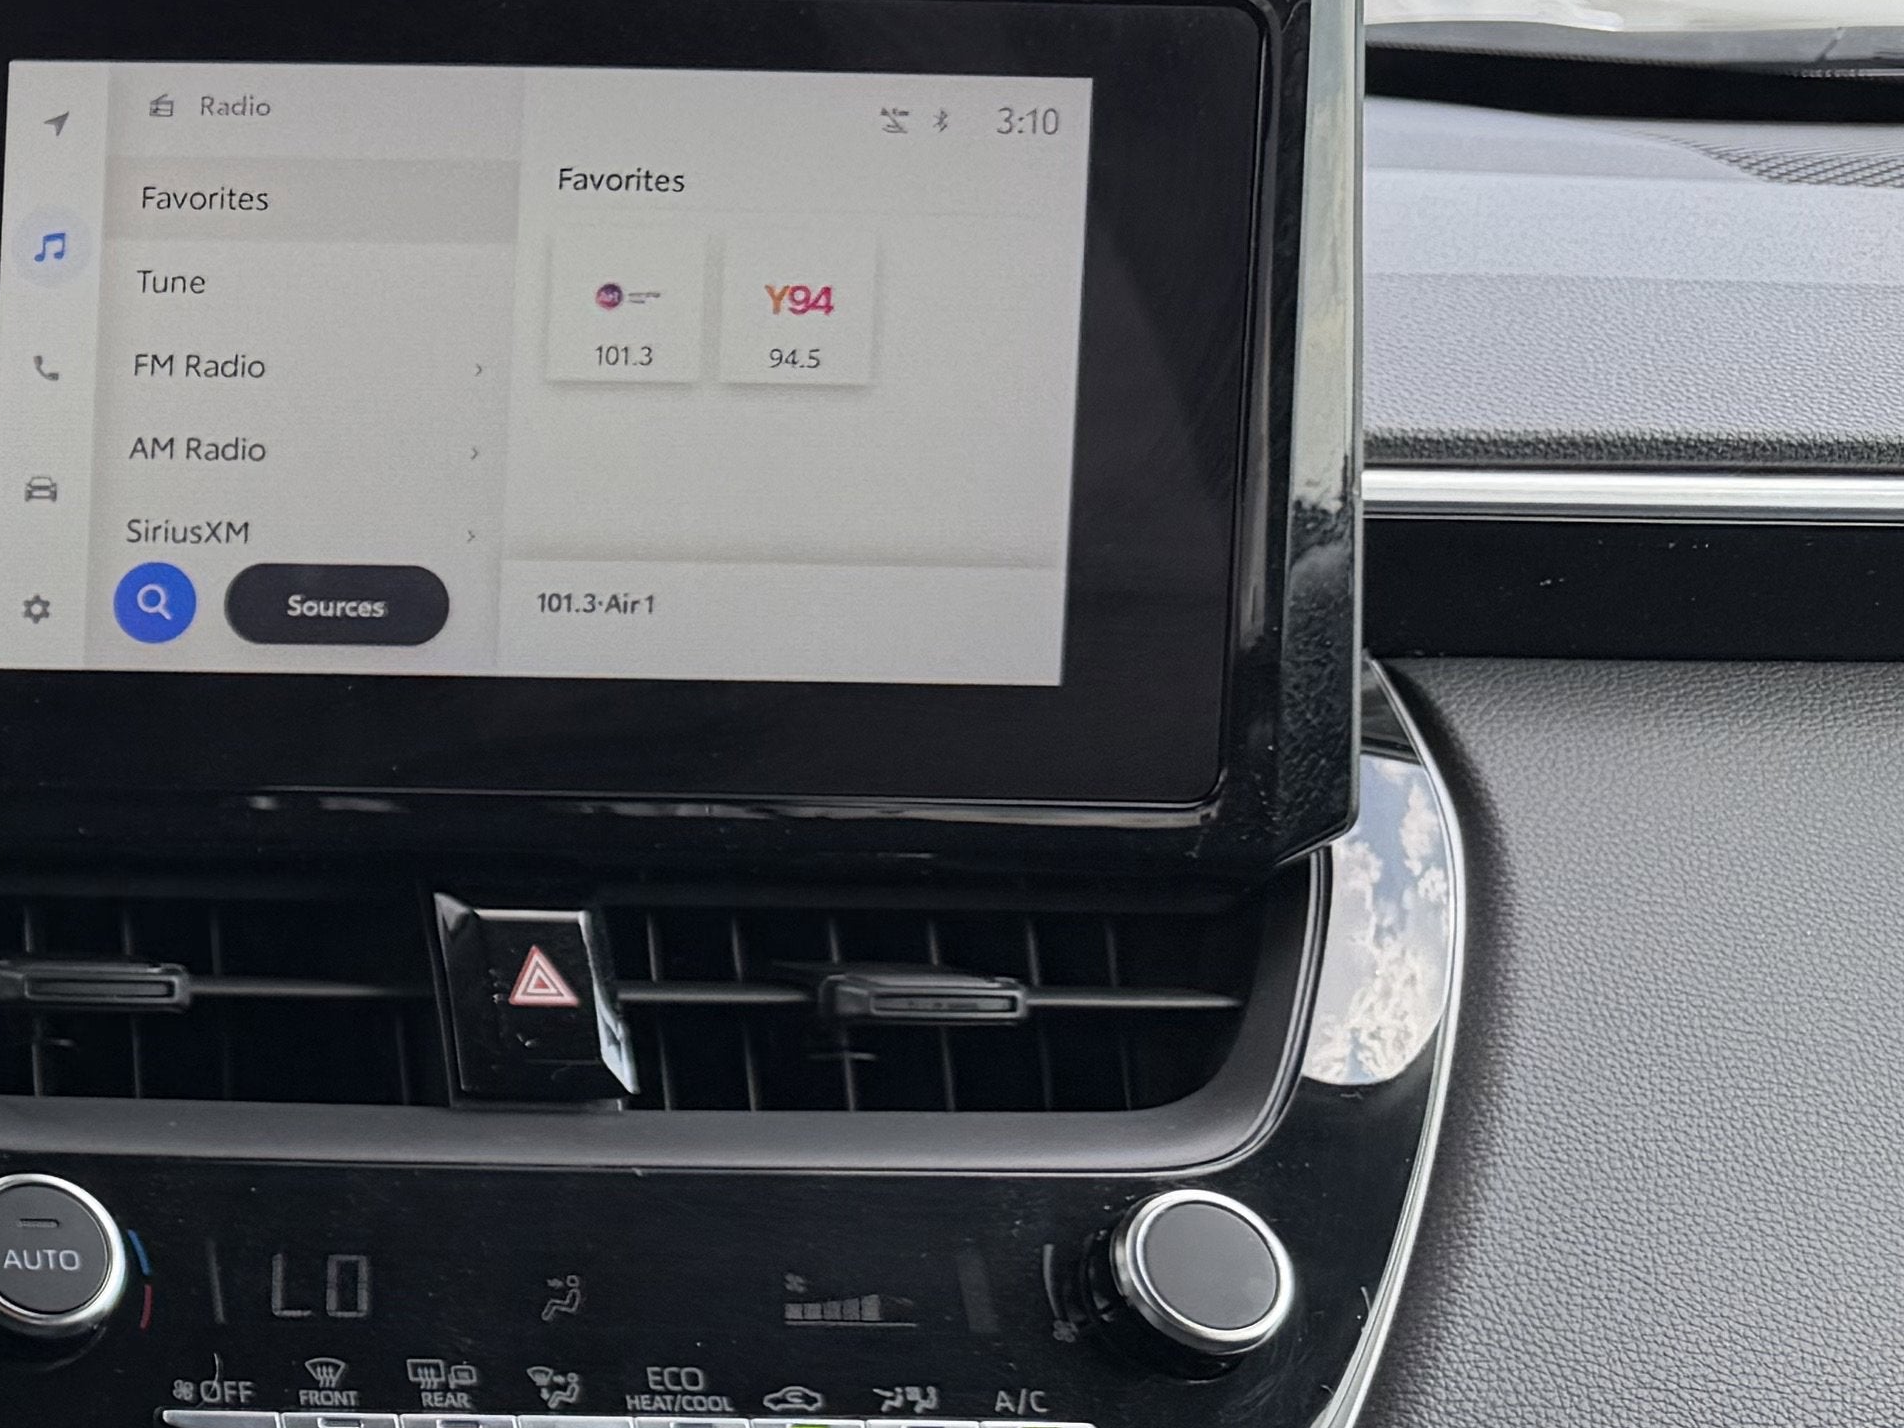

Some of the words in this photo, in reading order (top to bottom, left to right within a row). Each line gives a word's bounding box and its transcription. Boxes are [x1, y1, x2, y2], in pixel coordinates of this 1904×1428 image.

[200, 95, 272, 117] Radio
[997, 107, 1060, 135] 3:10
[558, 168, 685, 193] Favorites
[142, 186, 270, 211] Favorites
[137, 270, 206, 294] Tune
[764, 284, 835, 316] Y94
[134, 353, 175, 377] FM
[185, 353, 266, 378] Radio
[595, 345, 653, 366] 101.3
[769, 348, 821, 369] 94.5
[129, 437, 174, 460] AM
[186, 437, 267, 462] Radio
[126, 518, 249, 544] SiriusXM
[286, 594, 387, 618] Sources
[3, 1248, 80, 1271] AUTO
[646, 1367, 706, 1391] ECO
[200, 1380, 253, 1404] OFF
[299, 1390, 359, 1407] FRONT
[421, 1391, 471, 1408] REAR
[625, 1393, 734, 1413] HEAT/COOL
[994, 1390, 1049, 1414] A/C
